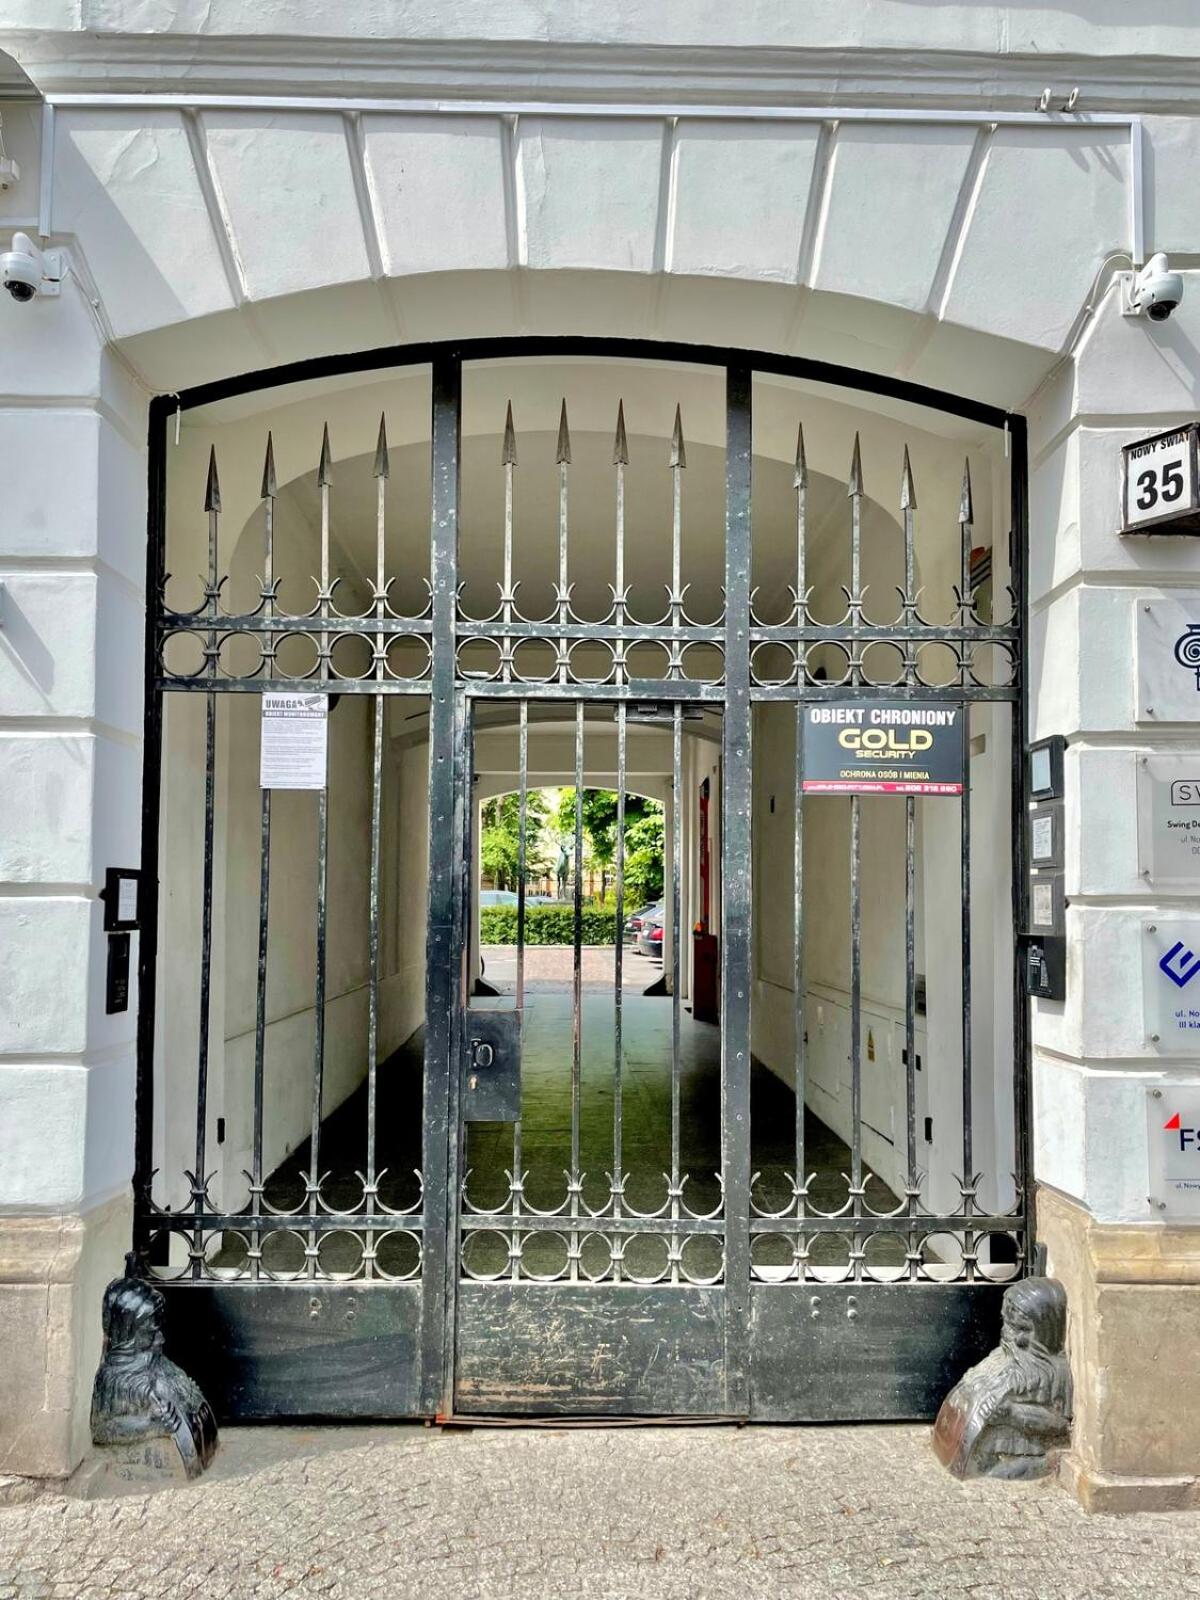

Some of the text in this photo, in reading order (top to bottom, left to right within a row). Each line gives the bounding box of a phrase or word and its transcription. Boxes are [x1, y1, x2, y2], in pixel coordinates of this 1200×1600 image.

[1131, 442, 1158, 461] NOWY
[1136, 459, 1184, 511] 35
[265, 699, 297, 709] UWAGA
[810, 708, 956, 726] OBIEKT CHRONIONY
[838, 728, 933, 751] GOLD
[855, 750, 916, 759] SECURITY
[840, 770, 877, 779] OCHRONA
[877, 770, 898, 779] OSÓB
[903, 771, 930, 780] MIENIA
[1167, 820, 1191, 830] Swing
